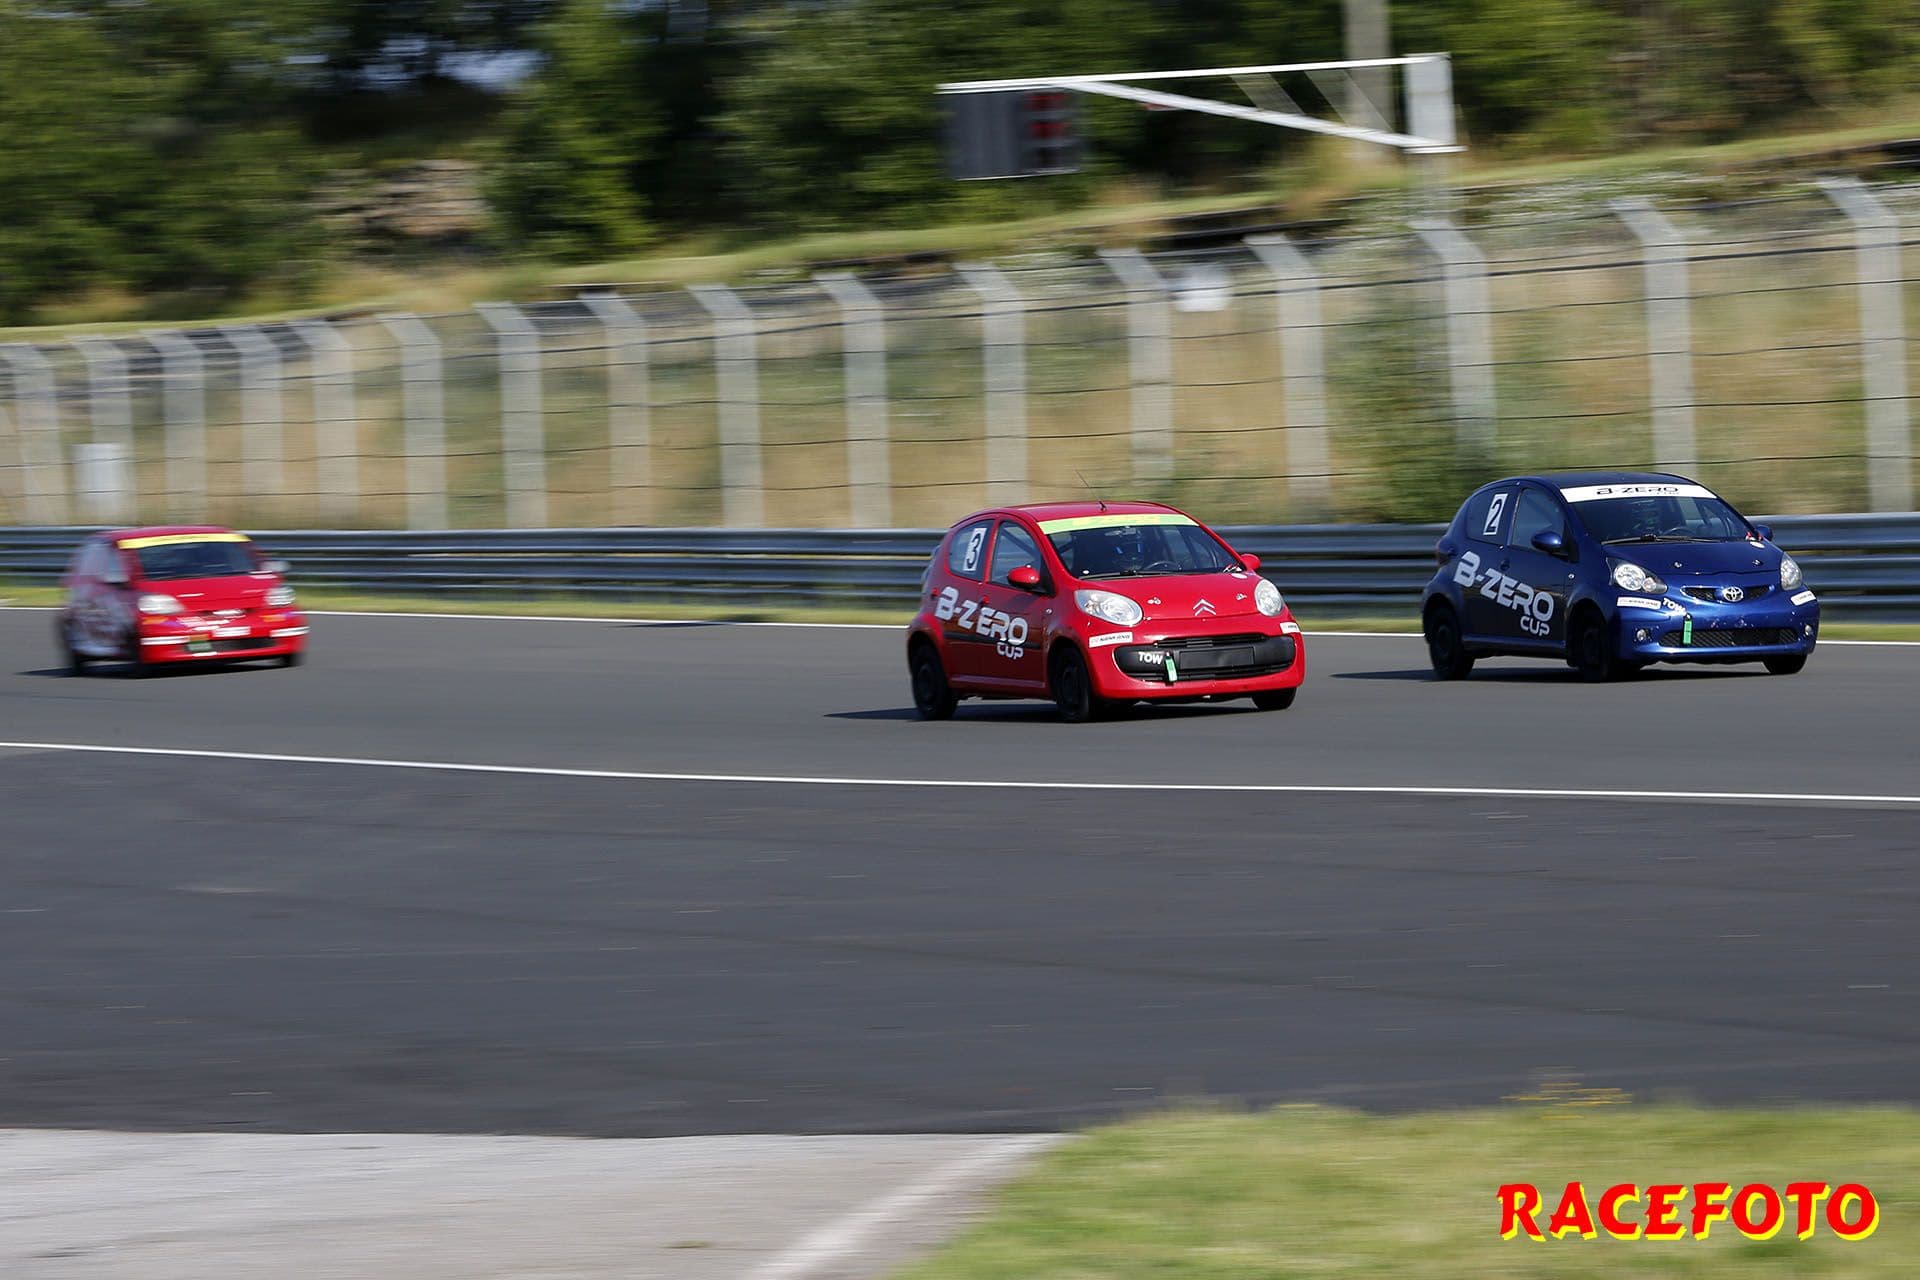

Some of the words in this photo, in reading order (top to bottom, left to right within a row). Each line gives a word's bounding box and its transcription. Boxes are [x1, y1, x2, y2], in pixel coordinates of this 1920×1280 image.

[1486, 498, 1503, 533] 2
[966, 532, 981, 569] 3
[1453, 550, 1554, 622] B-ZERO
[934, 586, 1028, 645] B-ZERO
[1662, 597, 1687, 616] TOW
[1520, 615, 1550, 637] CUP
[997, 641, 1024, 660] CUP
[1138, 651, 1163, 665] TOW
